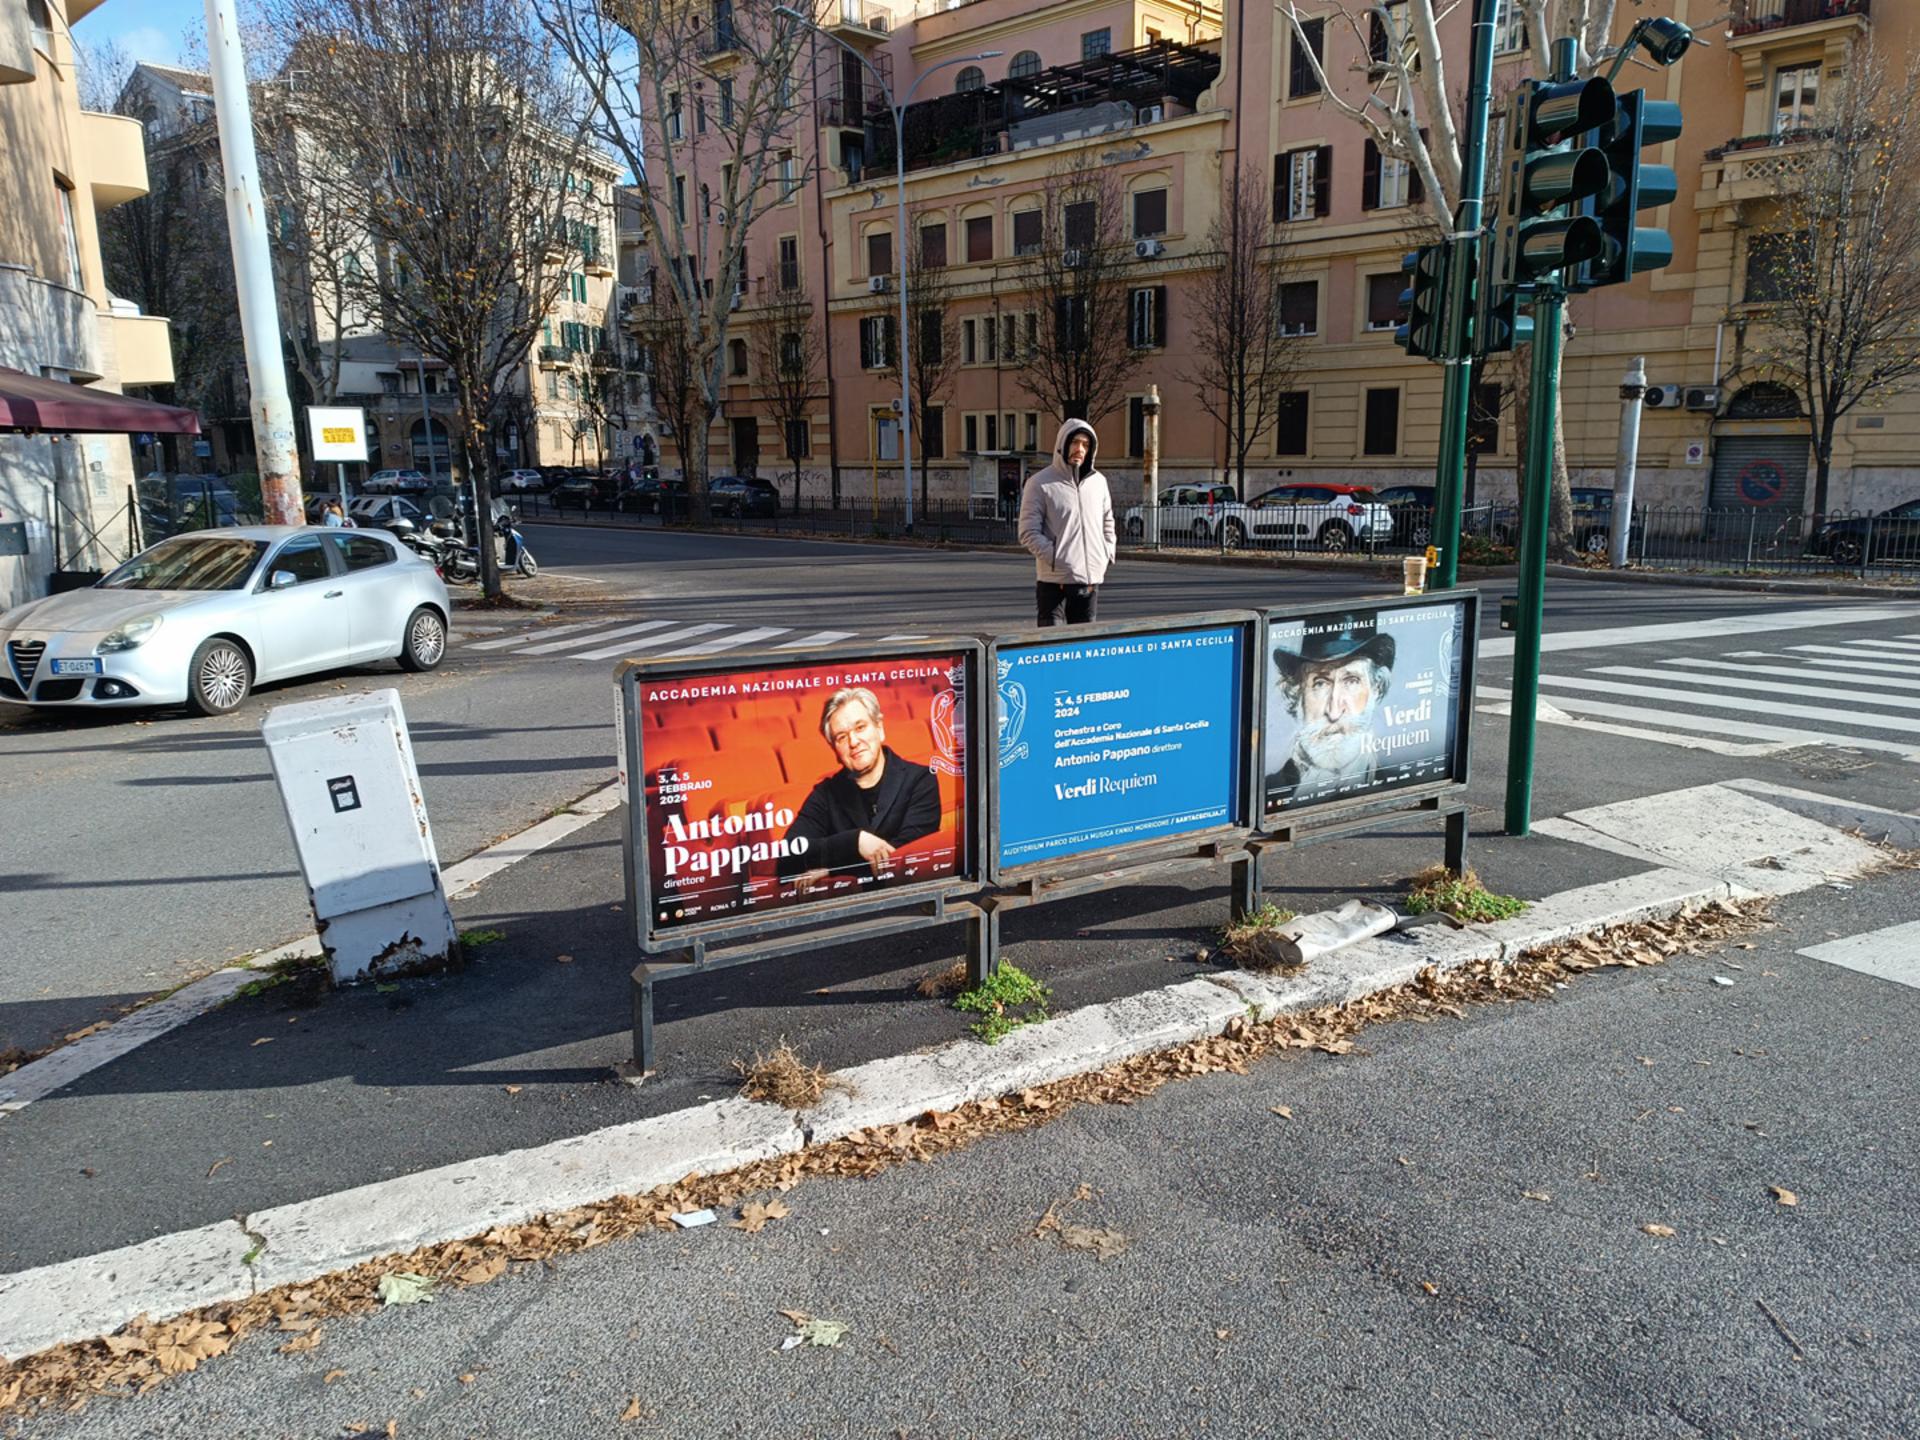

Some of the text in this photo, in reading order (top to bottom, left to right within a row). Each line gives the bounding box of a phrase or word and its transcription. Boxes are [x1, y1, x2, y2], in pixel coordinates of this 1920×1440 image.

[1272, 610, 1448, 640] ACCADEMIA NAZIONALE DI SANTA CECILIA
[1017, 635, 1234, 666] ACCADEMIA NAZIONALE DI SANTA CECILIA
[649, 667, 939, 702] ACCADEMIA NAZIONALE DI SANTA CECILIA
[1065, 696, 1075, 706] 4,
[1076, 694, 1083, 704] 5
[1083, 689, 1129, 703] FEBBRAIO
[1054, 707, 1080, 718] 2024
[1383, 699, 1432, 727] Verdi
[1054, 726, 1096, 738] Orchestra
[1103, 722, 1122, 731] Coro
[1115, 728, 1153, 740] Nazionale
[1153, 725, 1161, 735] di
[1162, 723, 1184, 733] Santa
[1184, 719, 1209, 730] Cecilia
[1360, 727, 1430, 757] Requiem
[1054, 742, 1183, 768] Antonio Pappano direttore
[658, 771, 690, 784] 3, 4, 5
[659, 779, 713, 794] FEBBRAIO
[1054, 773, 1157, 800] Verdi Requiem
[659, 793, 688, 805] 2024
[661, 801, 794, 845] Antonio
[1003, 842, 1045, 856] AUDITORIUM
[1045, 838, 1068, 848] PARCO
[1068, 834, 1089, 844] DELLA
[1090, 830, 1114, 839] MUSICA
[1114, 825, 1134, 835] ENNIO
[1134, 819, 1169, 831] MORRICONE
[663, 836, 810, 877] Pappano
[663, 875, 706, 889] direttore
